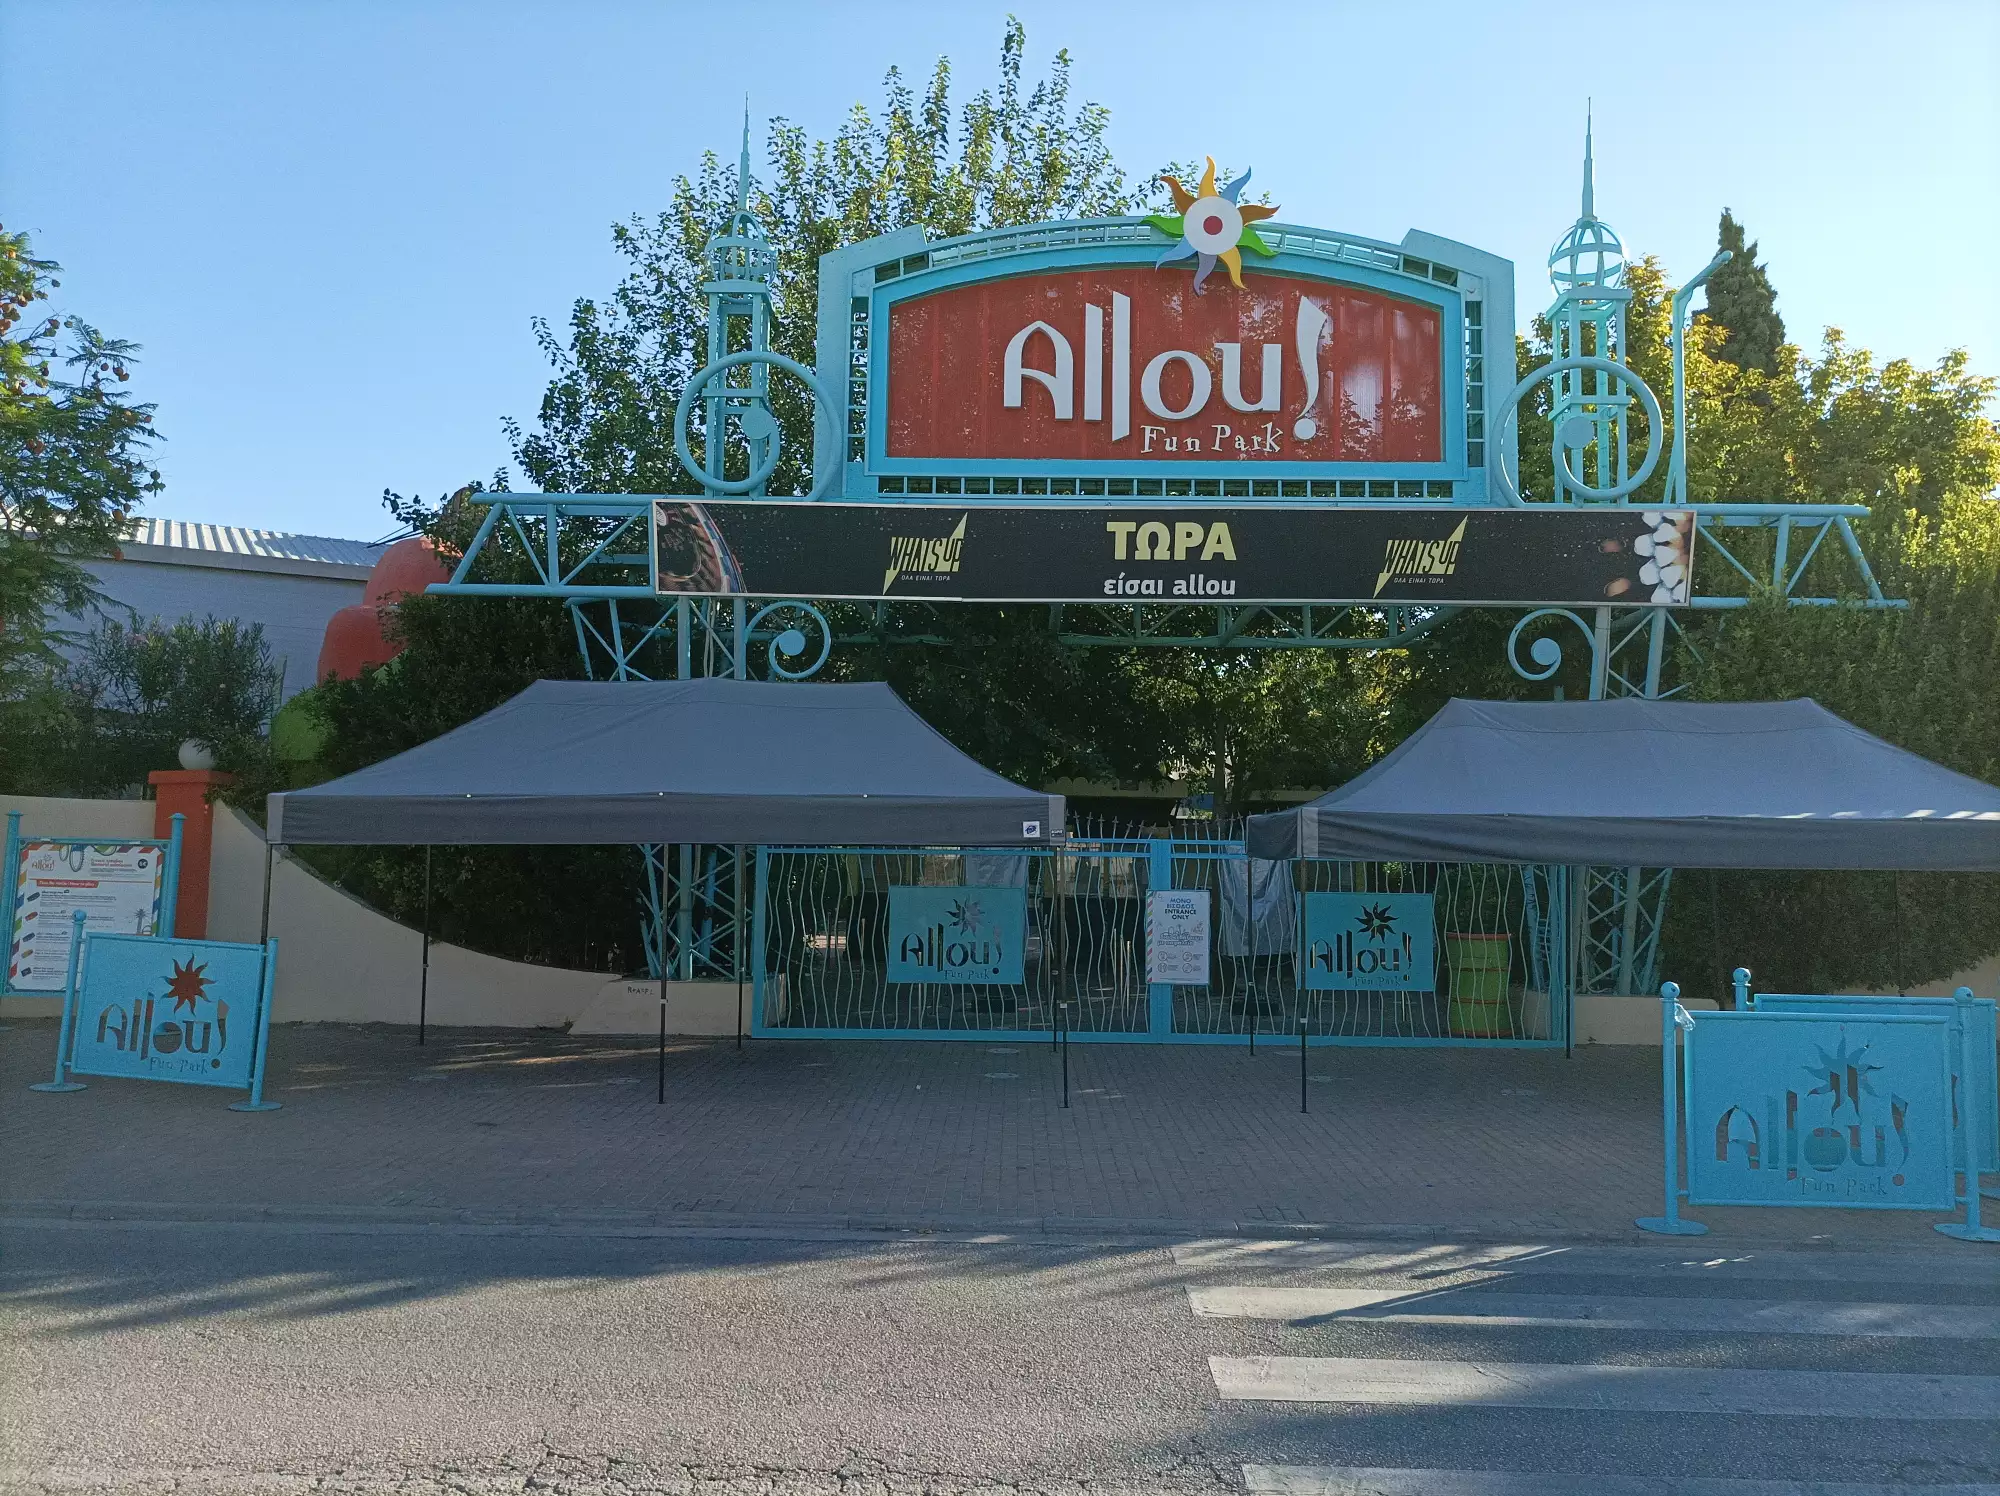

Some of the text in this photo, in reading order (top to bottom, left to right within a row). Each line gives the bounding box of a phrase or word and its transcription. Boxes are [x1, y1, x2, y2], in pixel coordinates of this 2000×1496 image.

[1004, 291, 1327, 441] Allou!
[1140, 422, 1284, 454] Fun Park
[1106, 521, 1237, 561] ΤΩΡΑ
[1103, 571, 1236, 595] είσαι allou
[900, 922, 1002, 975] Allou!
[1309, 929, 1412, 981] Allou!
[944, 969, 963, 980] Fun
[96, 991, 229, 1068] Allou!
[150, 1056, 208, 1074] Fun Park
[1715, 1089, 1909, 1187] Allou!
[1800, 1176, 1887, 1195] Fun Park
